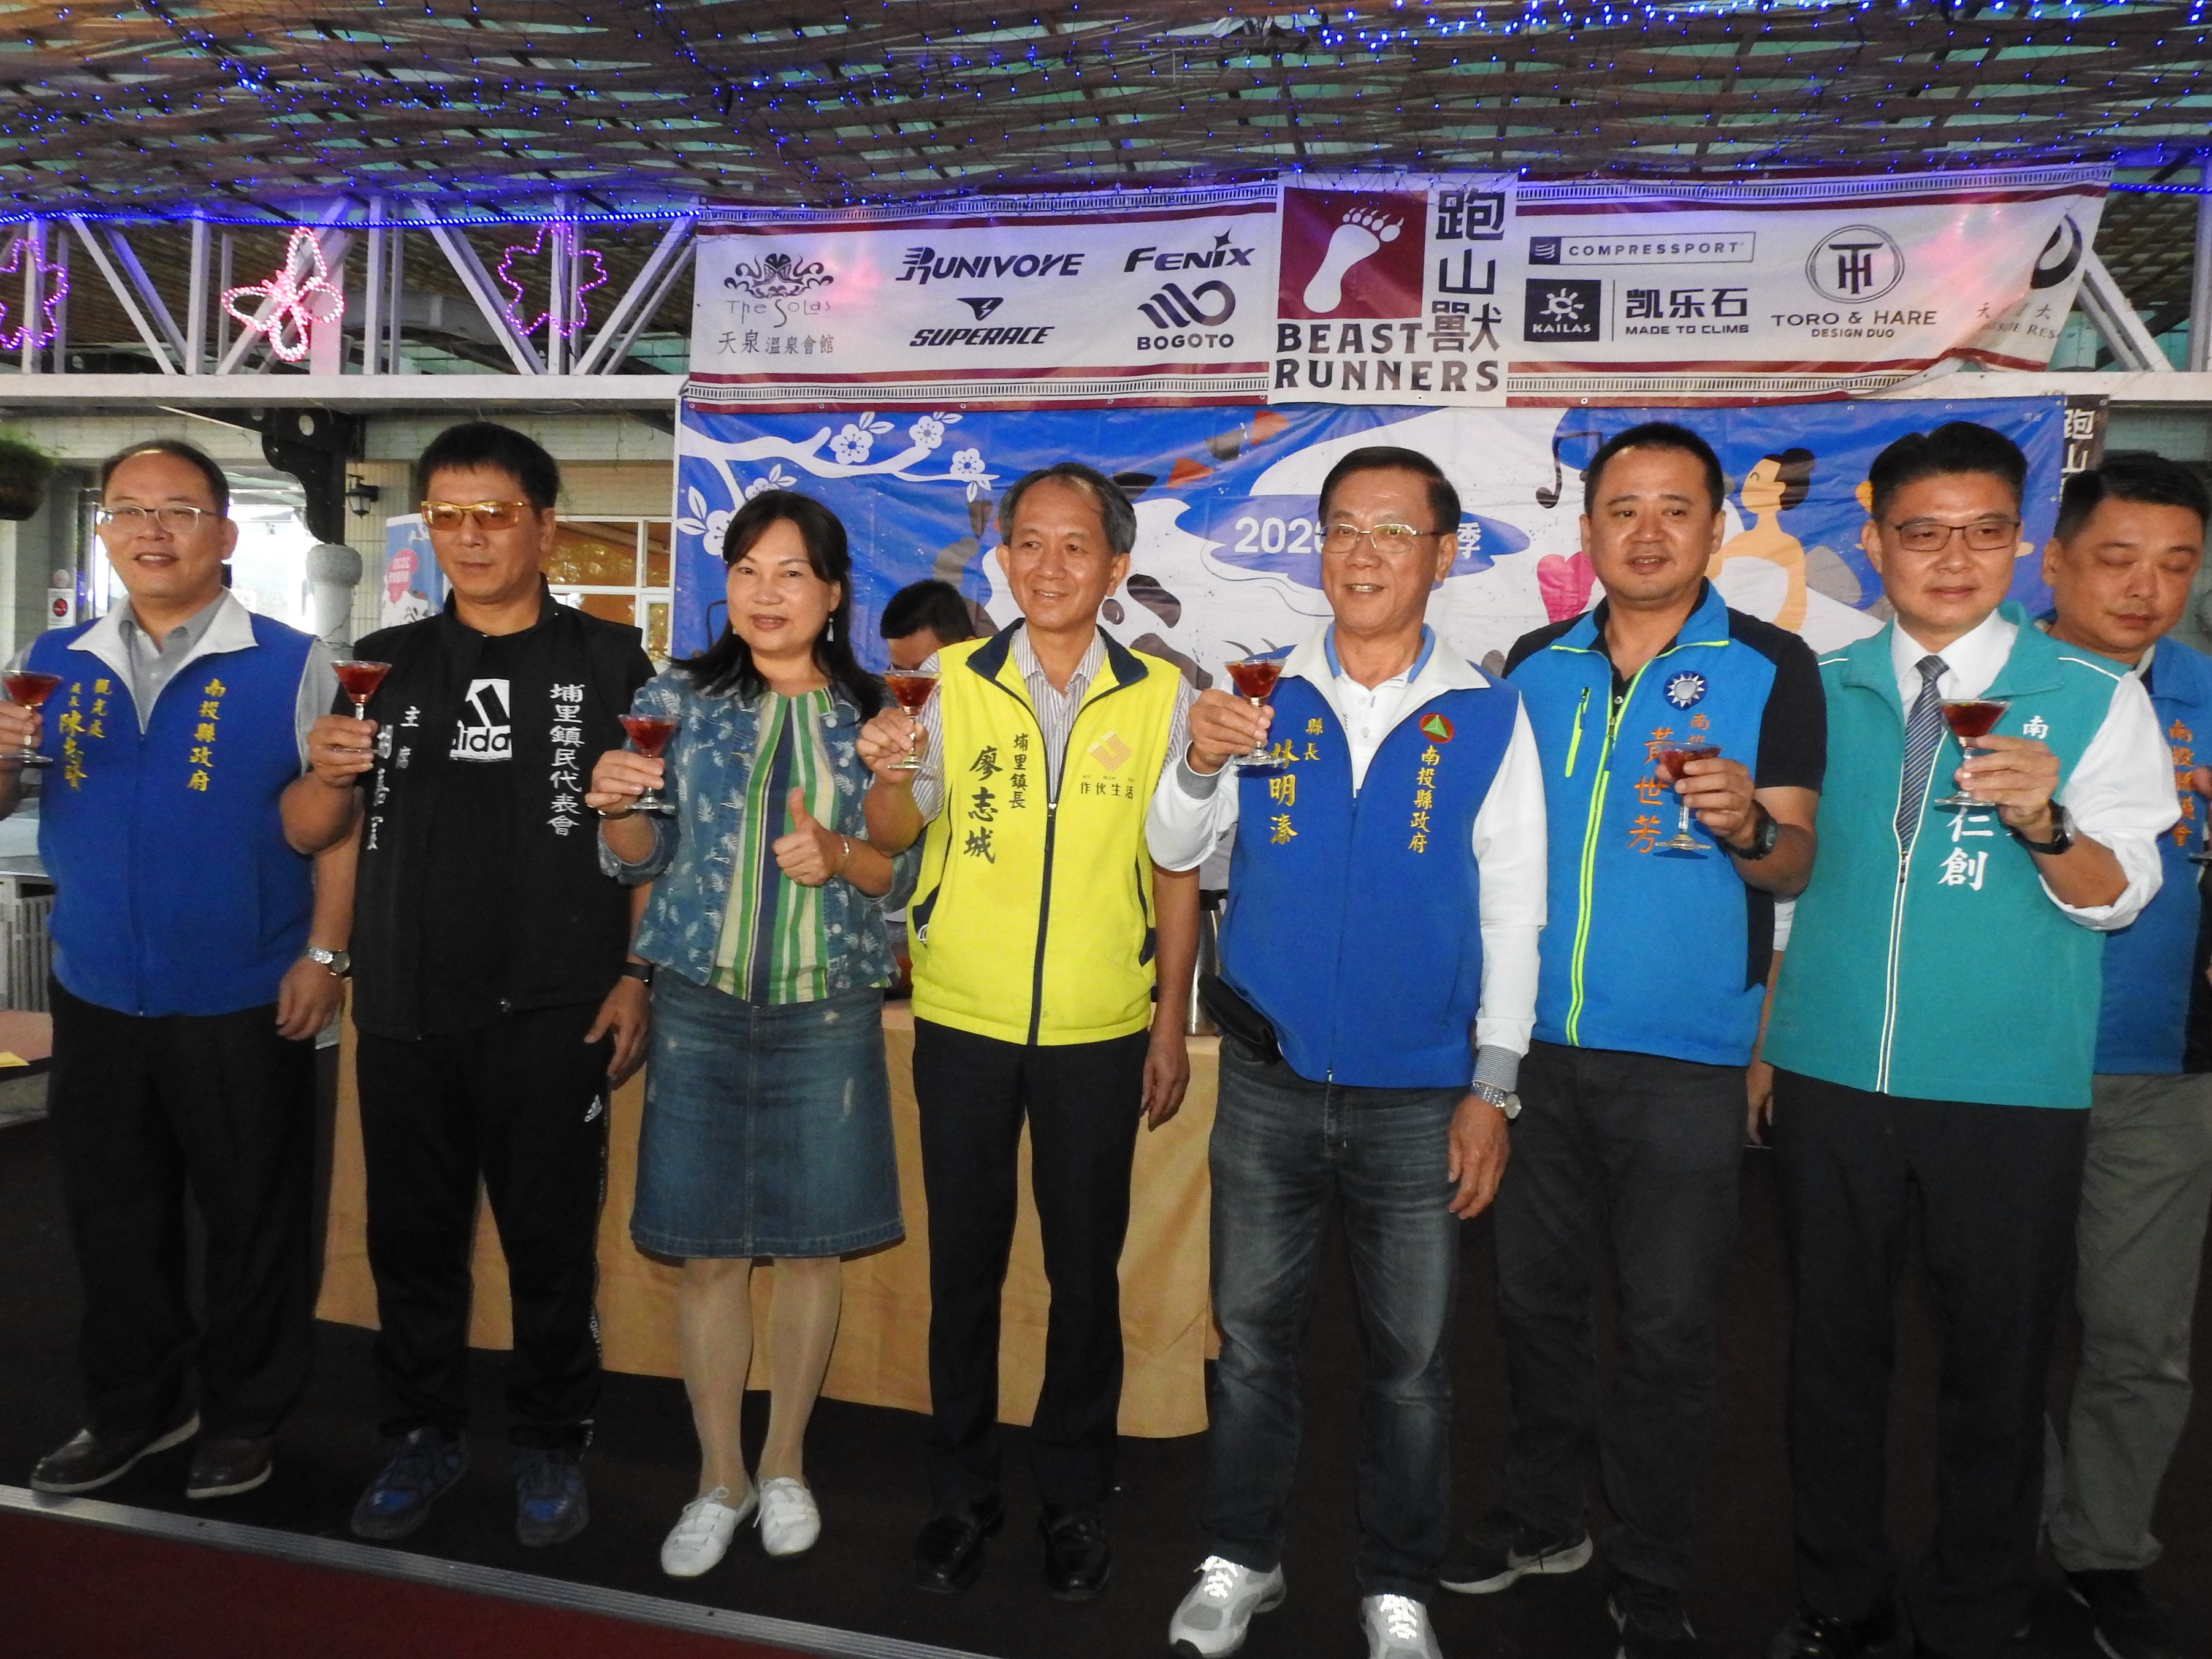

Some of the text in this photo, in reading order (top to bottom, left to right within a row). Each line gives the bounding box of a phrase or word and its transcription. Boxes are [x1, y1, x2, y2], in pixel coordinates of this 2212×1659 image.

[1569, 242, 1738, 256] COMPRESSPORT
[1427, 190, 1506, 353] 跑山獸
[1626, 289, 1748, 318] 凯乐石
[1771, 311, 1937, 326] TORO & HARE
[909, 327, 1055, 346] SUPERACE
[1137, 334, 1234, 350] BOGOTO
[1276, 322, 1422, 354] BEAST
[1533, 323, 1591, 334] KAILAS
[1626, 324, 1749, 335] MADE TO CLIMB
[1812, 329, 1894, 338] DESIGN DUO
[1275, 359, 1498, 392] RUNNERS
[187, 678, 226, 791] 南投縣政府
[1303, 718, 1323, 761] 縣長
[2023, 715, 2049, 739] 南
[547, 683, 585, 836] 埔里鎮民代表會
[1009, 733, 1029, 809] 埔里鎮長
[963, 746, 1003, 864] 廖志城
[1080, 782, 1134, 800] 作伙生活
[1408, 745, 1441, 853] 南投縣政府
[1937, 806, 1994, 891] 仁創
